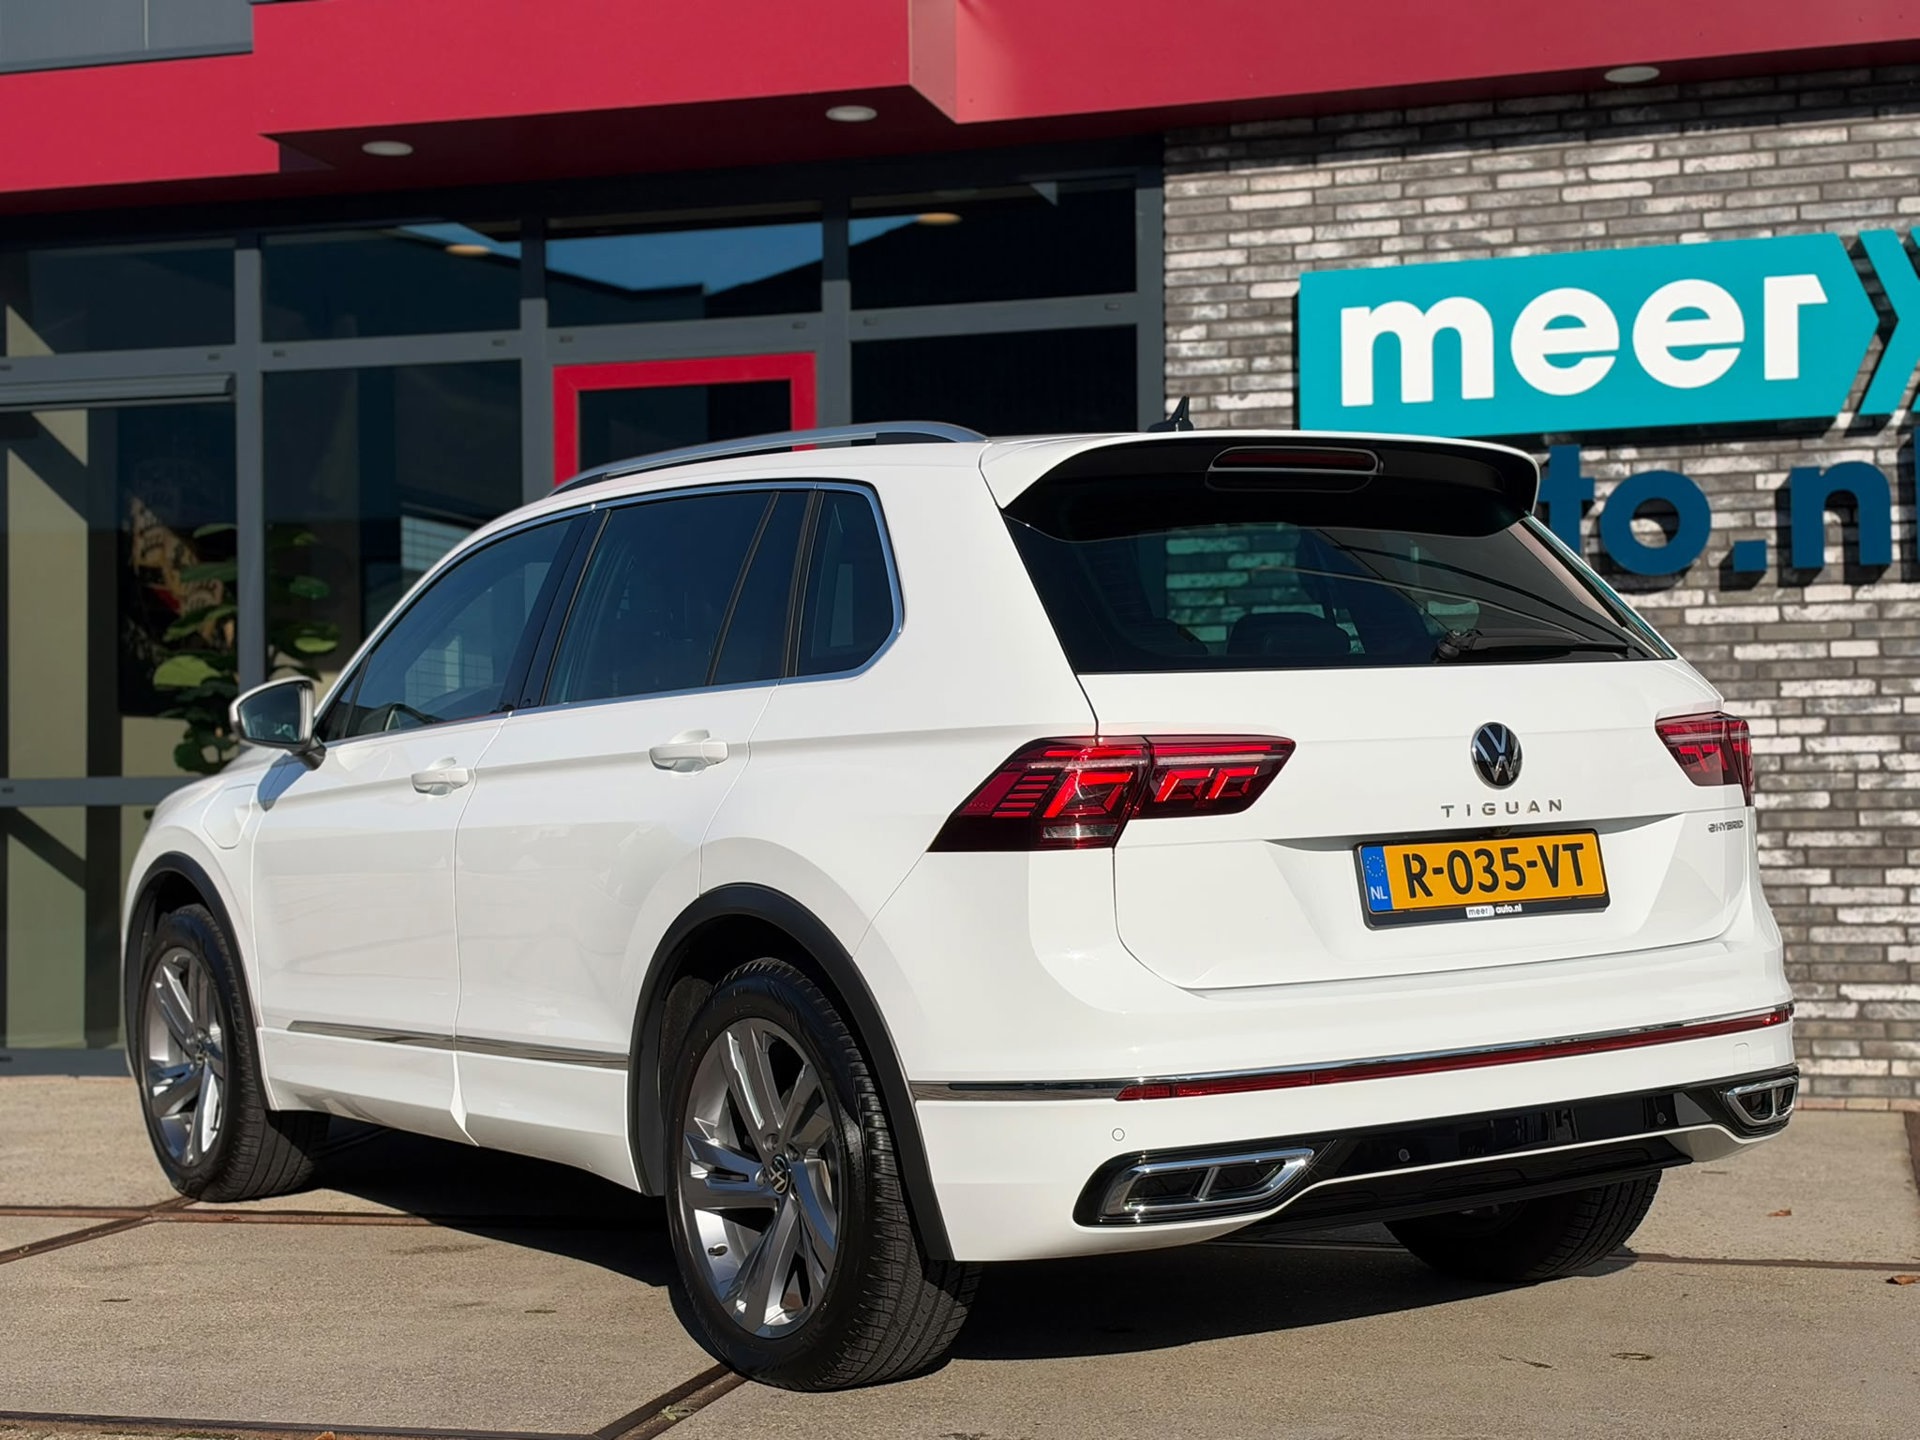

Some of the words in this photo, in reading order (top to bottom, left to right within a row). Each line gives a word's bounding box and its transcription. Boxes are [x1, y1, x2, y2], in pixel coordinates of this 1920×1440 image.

[1341, 275, 1828, 407] meer
[1539, 425, 1920, 577] to.n
[1441, 799, 1562, 818] TIGUAN
[1403, 843, 1584, 899] R-035-VT
[1371, 886, 1388, 899] NL
[1468, 907, 1489, 916] meer
[1495, 903, 1523, 914] auto.nl
